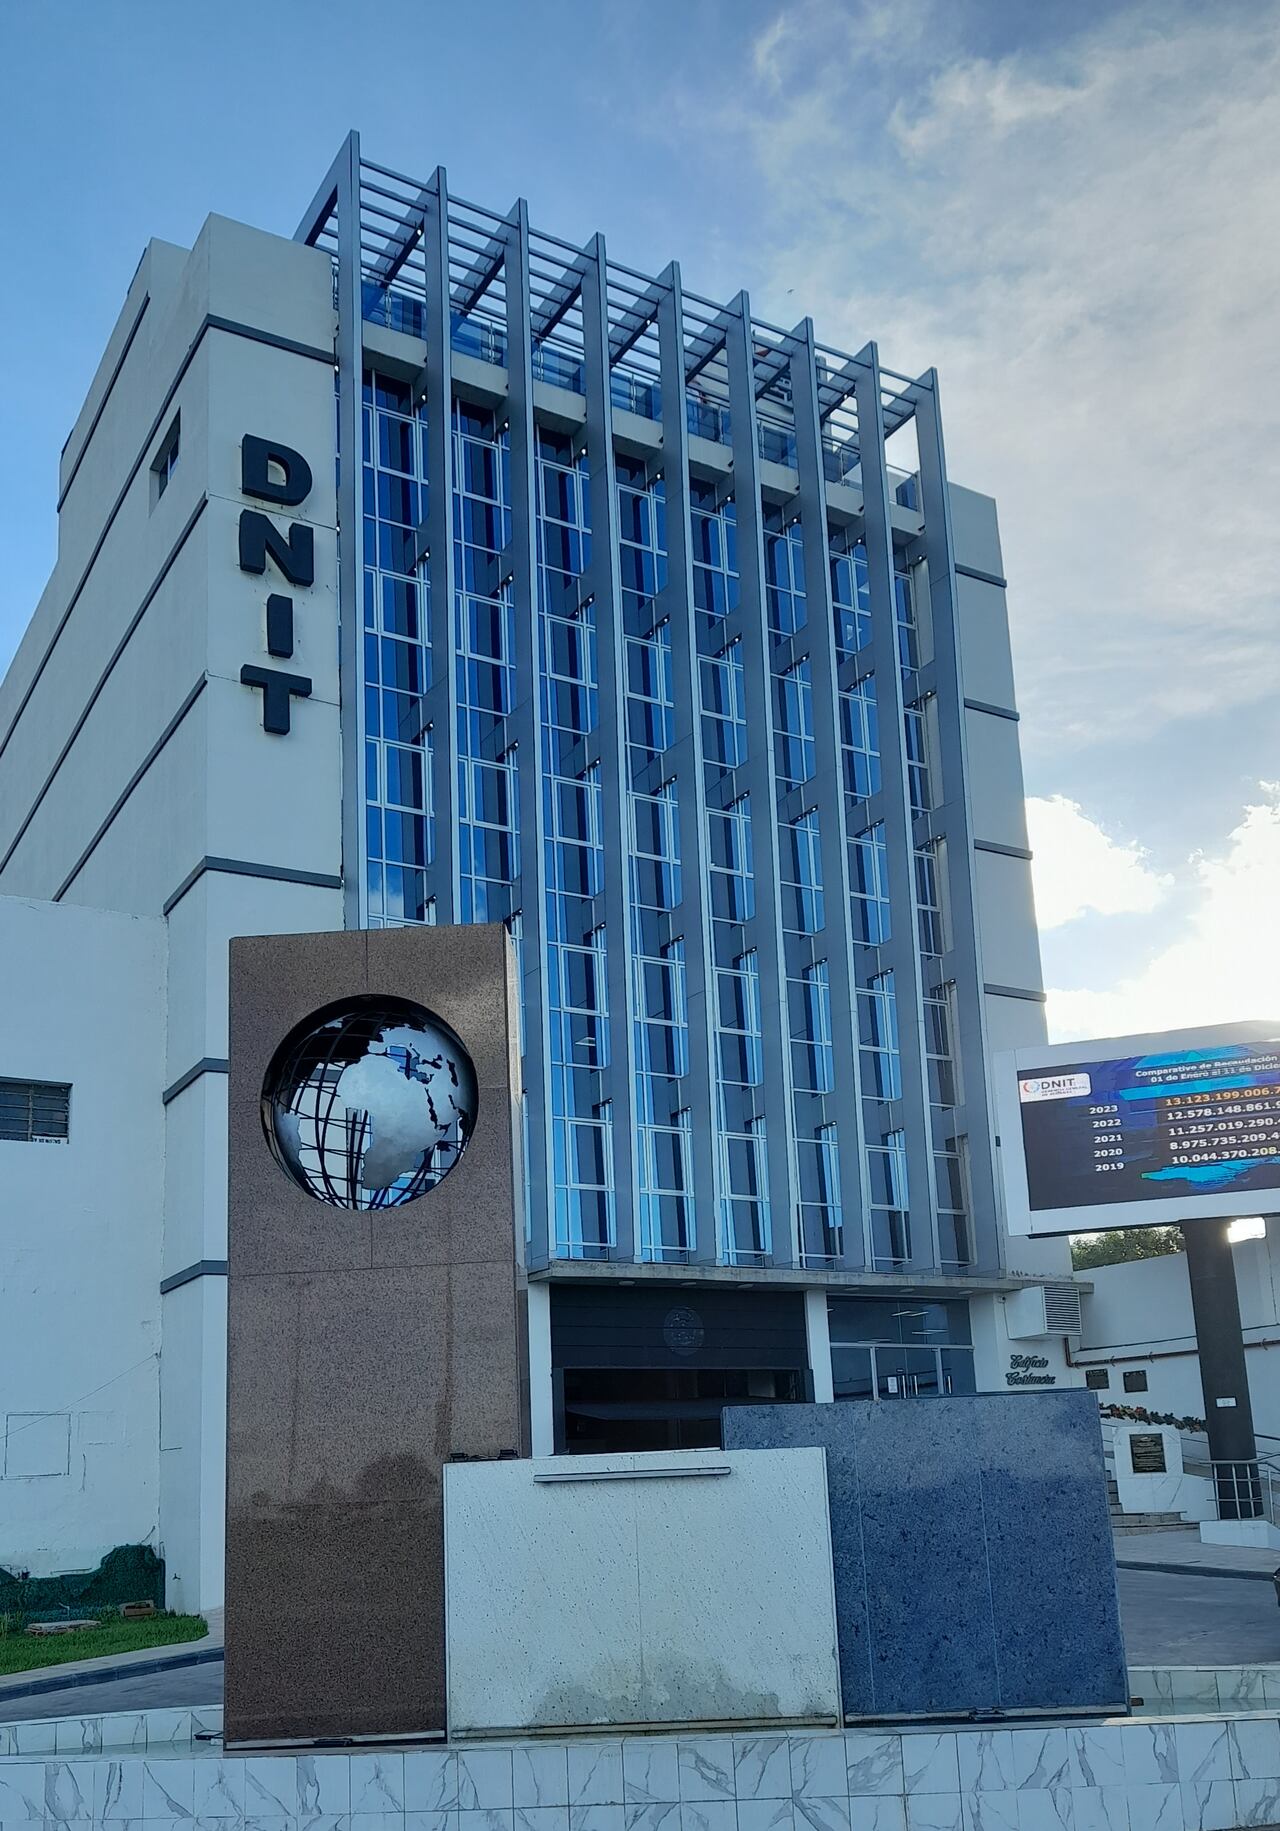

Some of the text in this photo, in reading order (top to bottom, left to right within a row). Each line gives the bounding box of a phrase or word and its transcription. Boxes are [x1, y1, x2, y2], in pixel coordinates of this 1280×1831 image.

[239, 433, 314, 736] DNIT
[1200, 1062, 1212, 1070] de
[1181, 1072, 1209, 1080] Enero
[1041, 1078, 1075, 1090] DNIT
[1089, 1105, 1118, 1115] 2023
[1092, 1119, 1122, 1128] 2022
[1168, 1117, 1280, 1136] 11.257.019.290.
[1094, 1134, 1123, 1143] 2021
[1094, 1148, 1123, 1158] 2020
[1095, 1162, 1124, 1172] 2019
